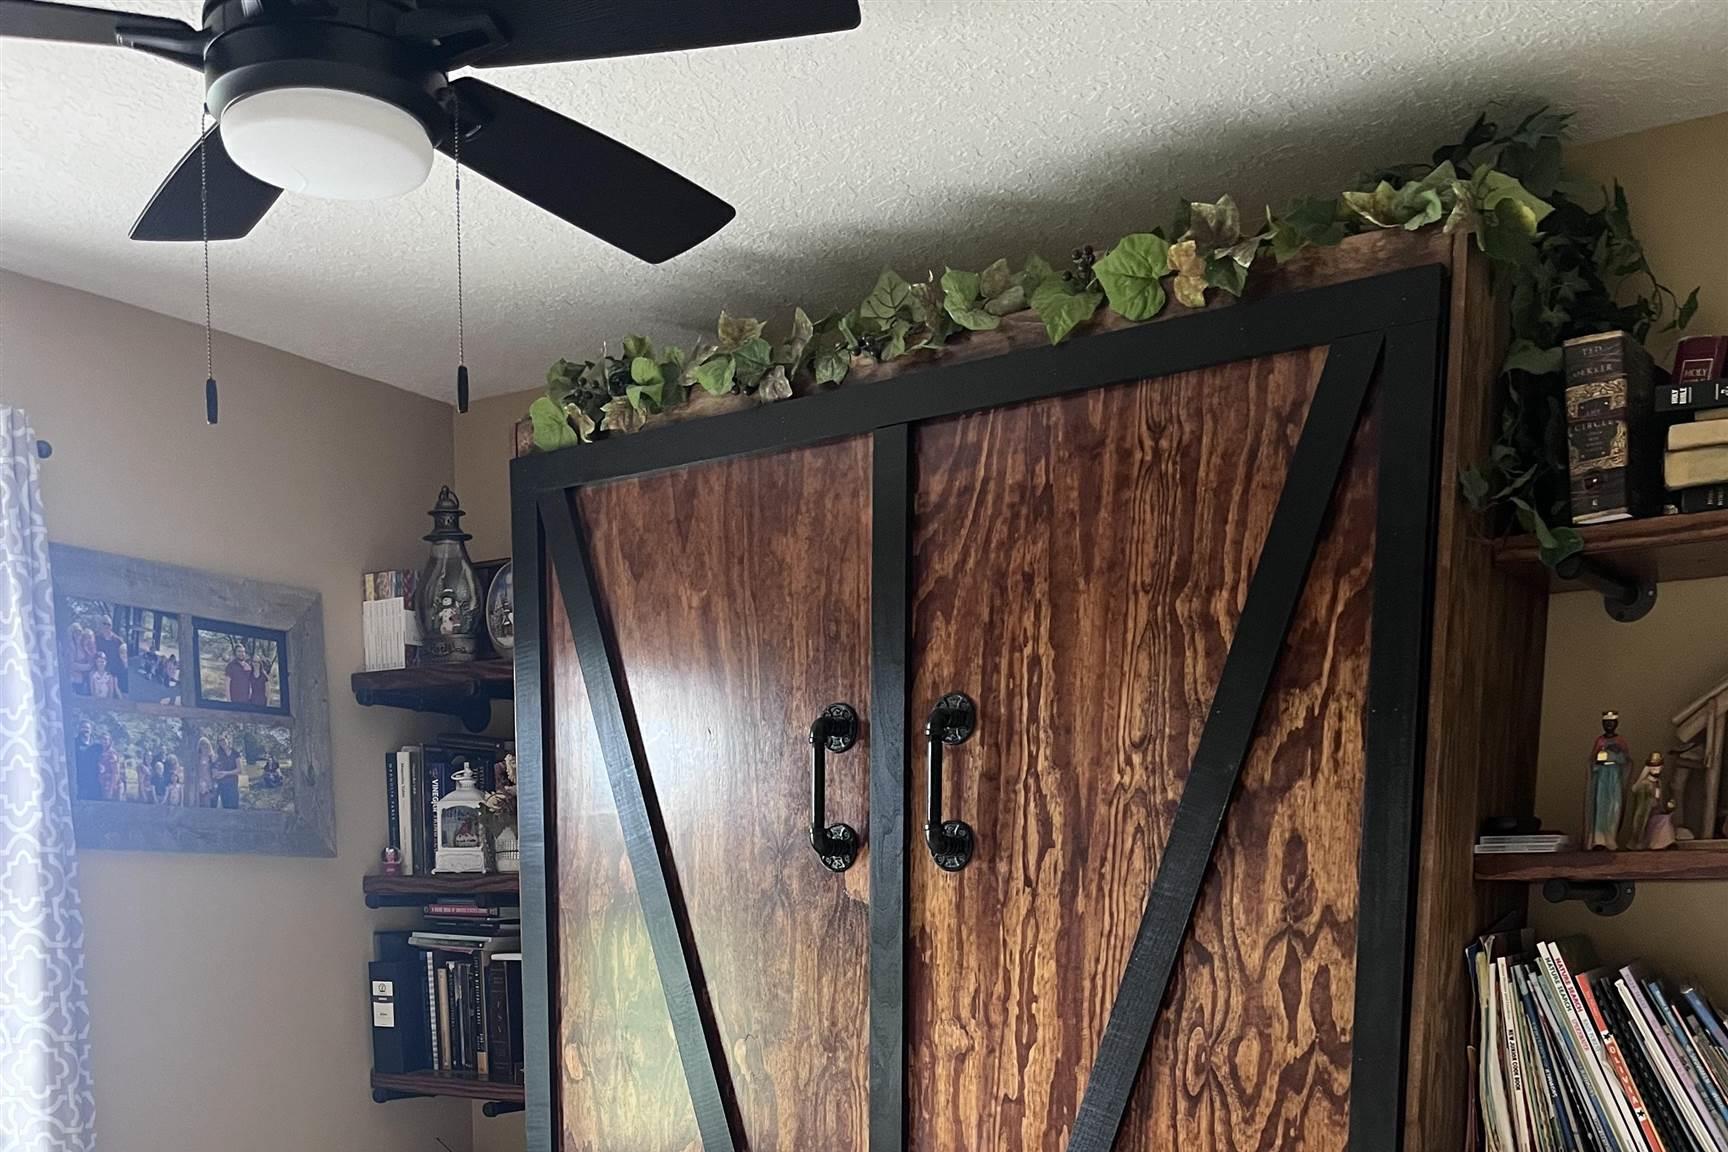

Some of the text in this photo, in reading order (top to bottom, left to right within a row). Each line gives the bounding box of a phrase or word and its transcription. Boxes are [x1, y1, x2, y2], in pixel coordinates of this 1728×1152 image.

[1684, 368, 1709, 377] HOLY
[1545, 957, 1560, 985] NATURE
[1557, 986, 1572, 1012] SEARCH
[1555, 958, 1571, 985] NATURE
[1568, 986, 1583, 1012] SEARCH
[1509, 1041, 1517, 1062] JUNIOR
[1608, 1045, 1639, 1108] OLIVIA
